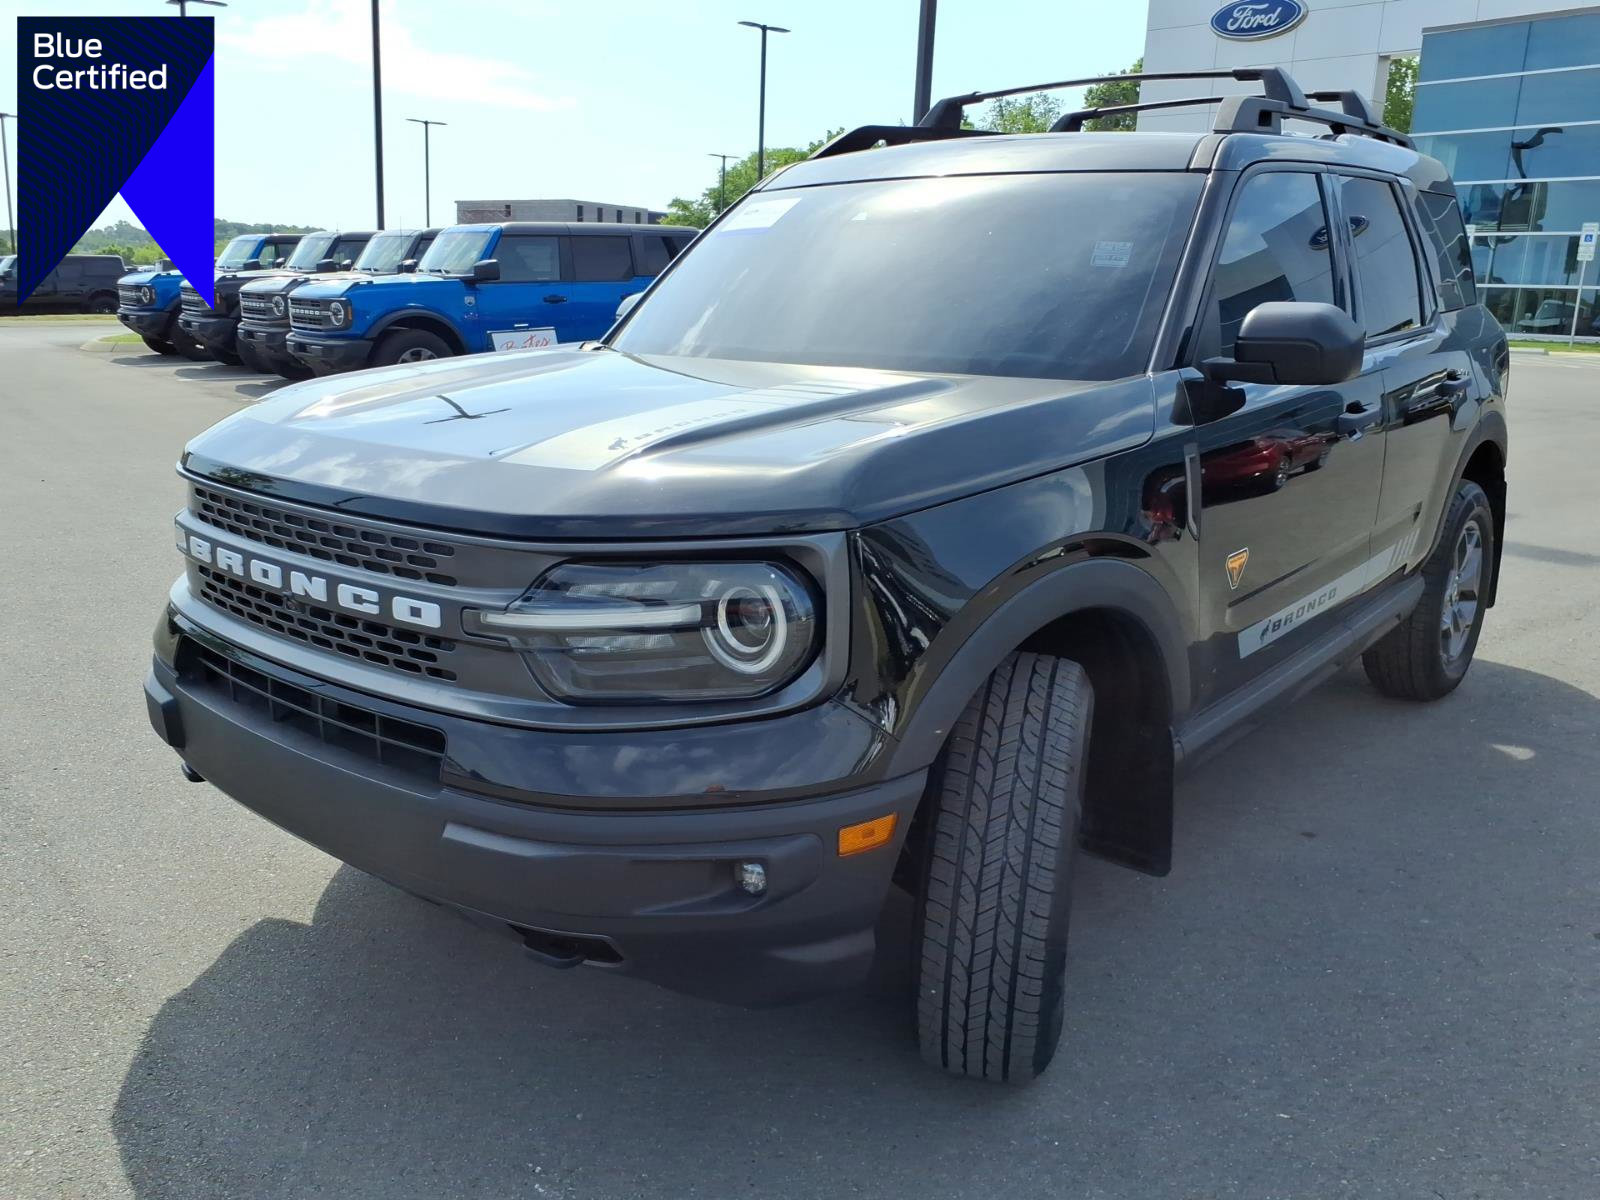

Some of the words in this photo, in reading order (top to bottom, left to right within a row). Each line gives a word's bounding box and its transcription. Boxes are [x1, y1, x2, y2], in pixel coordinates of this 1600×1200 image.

[1227, 3, 1281, 30] Ford
[189, 535, 442, 629] BRONCO
[1271, 587, 1337, 633] BRONCO
